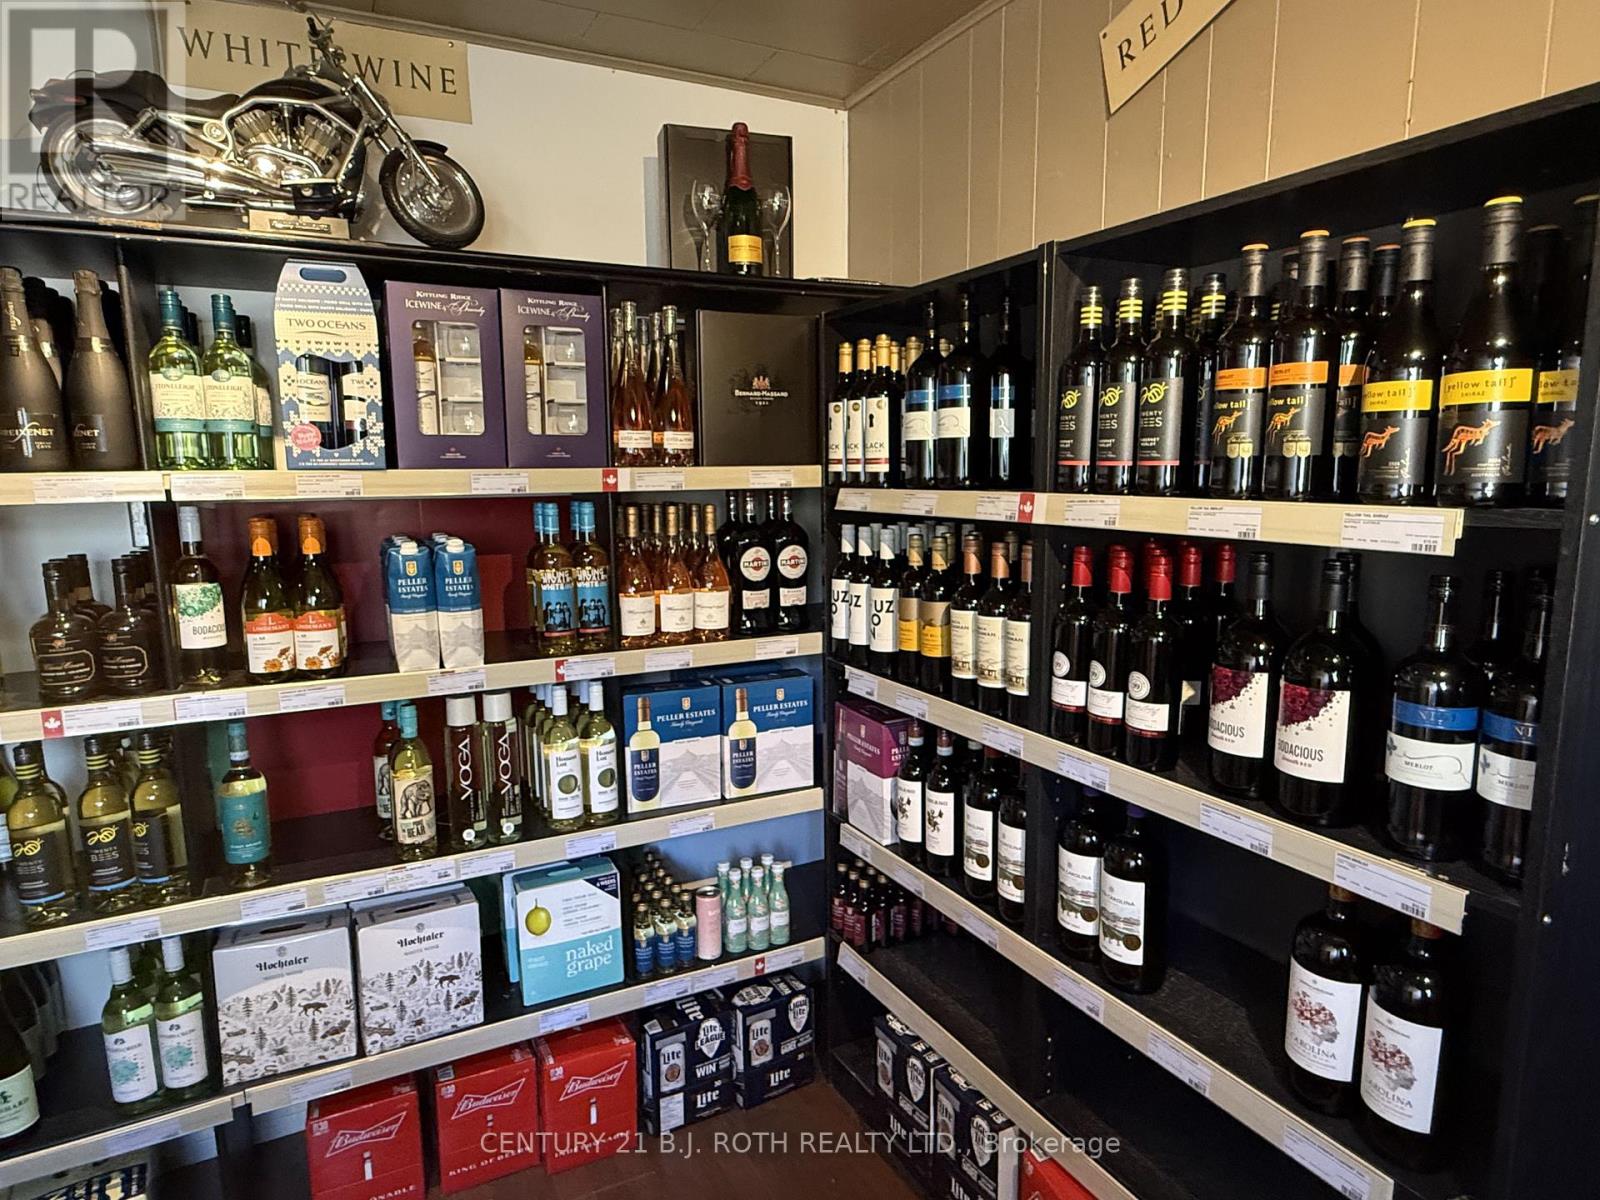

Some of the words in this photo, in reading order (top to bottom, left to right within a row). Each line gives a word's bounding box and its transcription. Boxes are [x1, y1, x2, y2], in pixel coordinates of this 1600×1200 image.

[1116, 0, 1184, 71] RED
[352, 53, 457, 95] WINE
[405, 298, 442, 310] ICEWINE
[517, 305, 551, 315] ICEWINE
[286, 318, 315, 328] TWO
[317, 319, 366, 331] OCEANS
[397, 577, 428, 586] PELLER
[397, 585, 429, 593] ESTATES
[753, 702, 779, 713] PELLER
[779, 700, 808, 711] ESTATES
[656, 711, 685, 722] PELLER
[685, 708, 716, 720] ESTATES
[458, 735, 472, 800] VOGA
[498, 733, 511, 795] VOGA
[1404, 760, 1434, 771] MERLOT
[396, 930, 445, 948] Hochtaler
[566, 935, 613, 961] naked
[255, 956, 309, 972] Hochtaler
[566, 953, 612, 978] grape
[703, 1024, 718, 1037] Lite
[751, 1026, 769, 1041] Lite
[662, 1050, 682, 1065] Lite
[695, 1062, 718, 1078] WIN
[769, 1068, 791, 1087] Lite
[567, 1071, 621, 1094] Budweiser
[458, 1087, 518, 1112] Budweiser
[696, 1089, 720, 1108] Lite
[334, 1122, 400, 1149] Budweiser
[449, 1163, 476, 1177] KING
